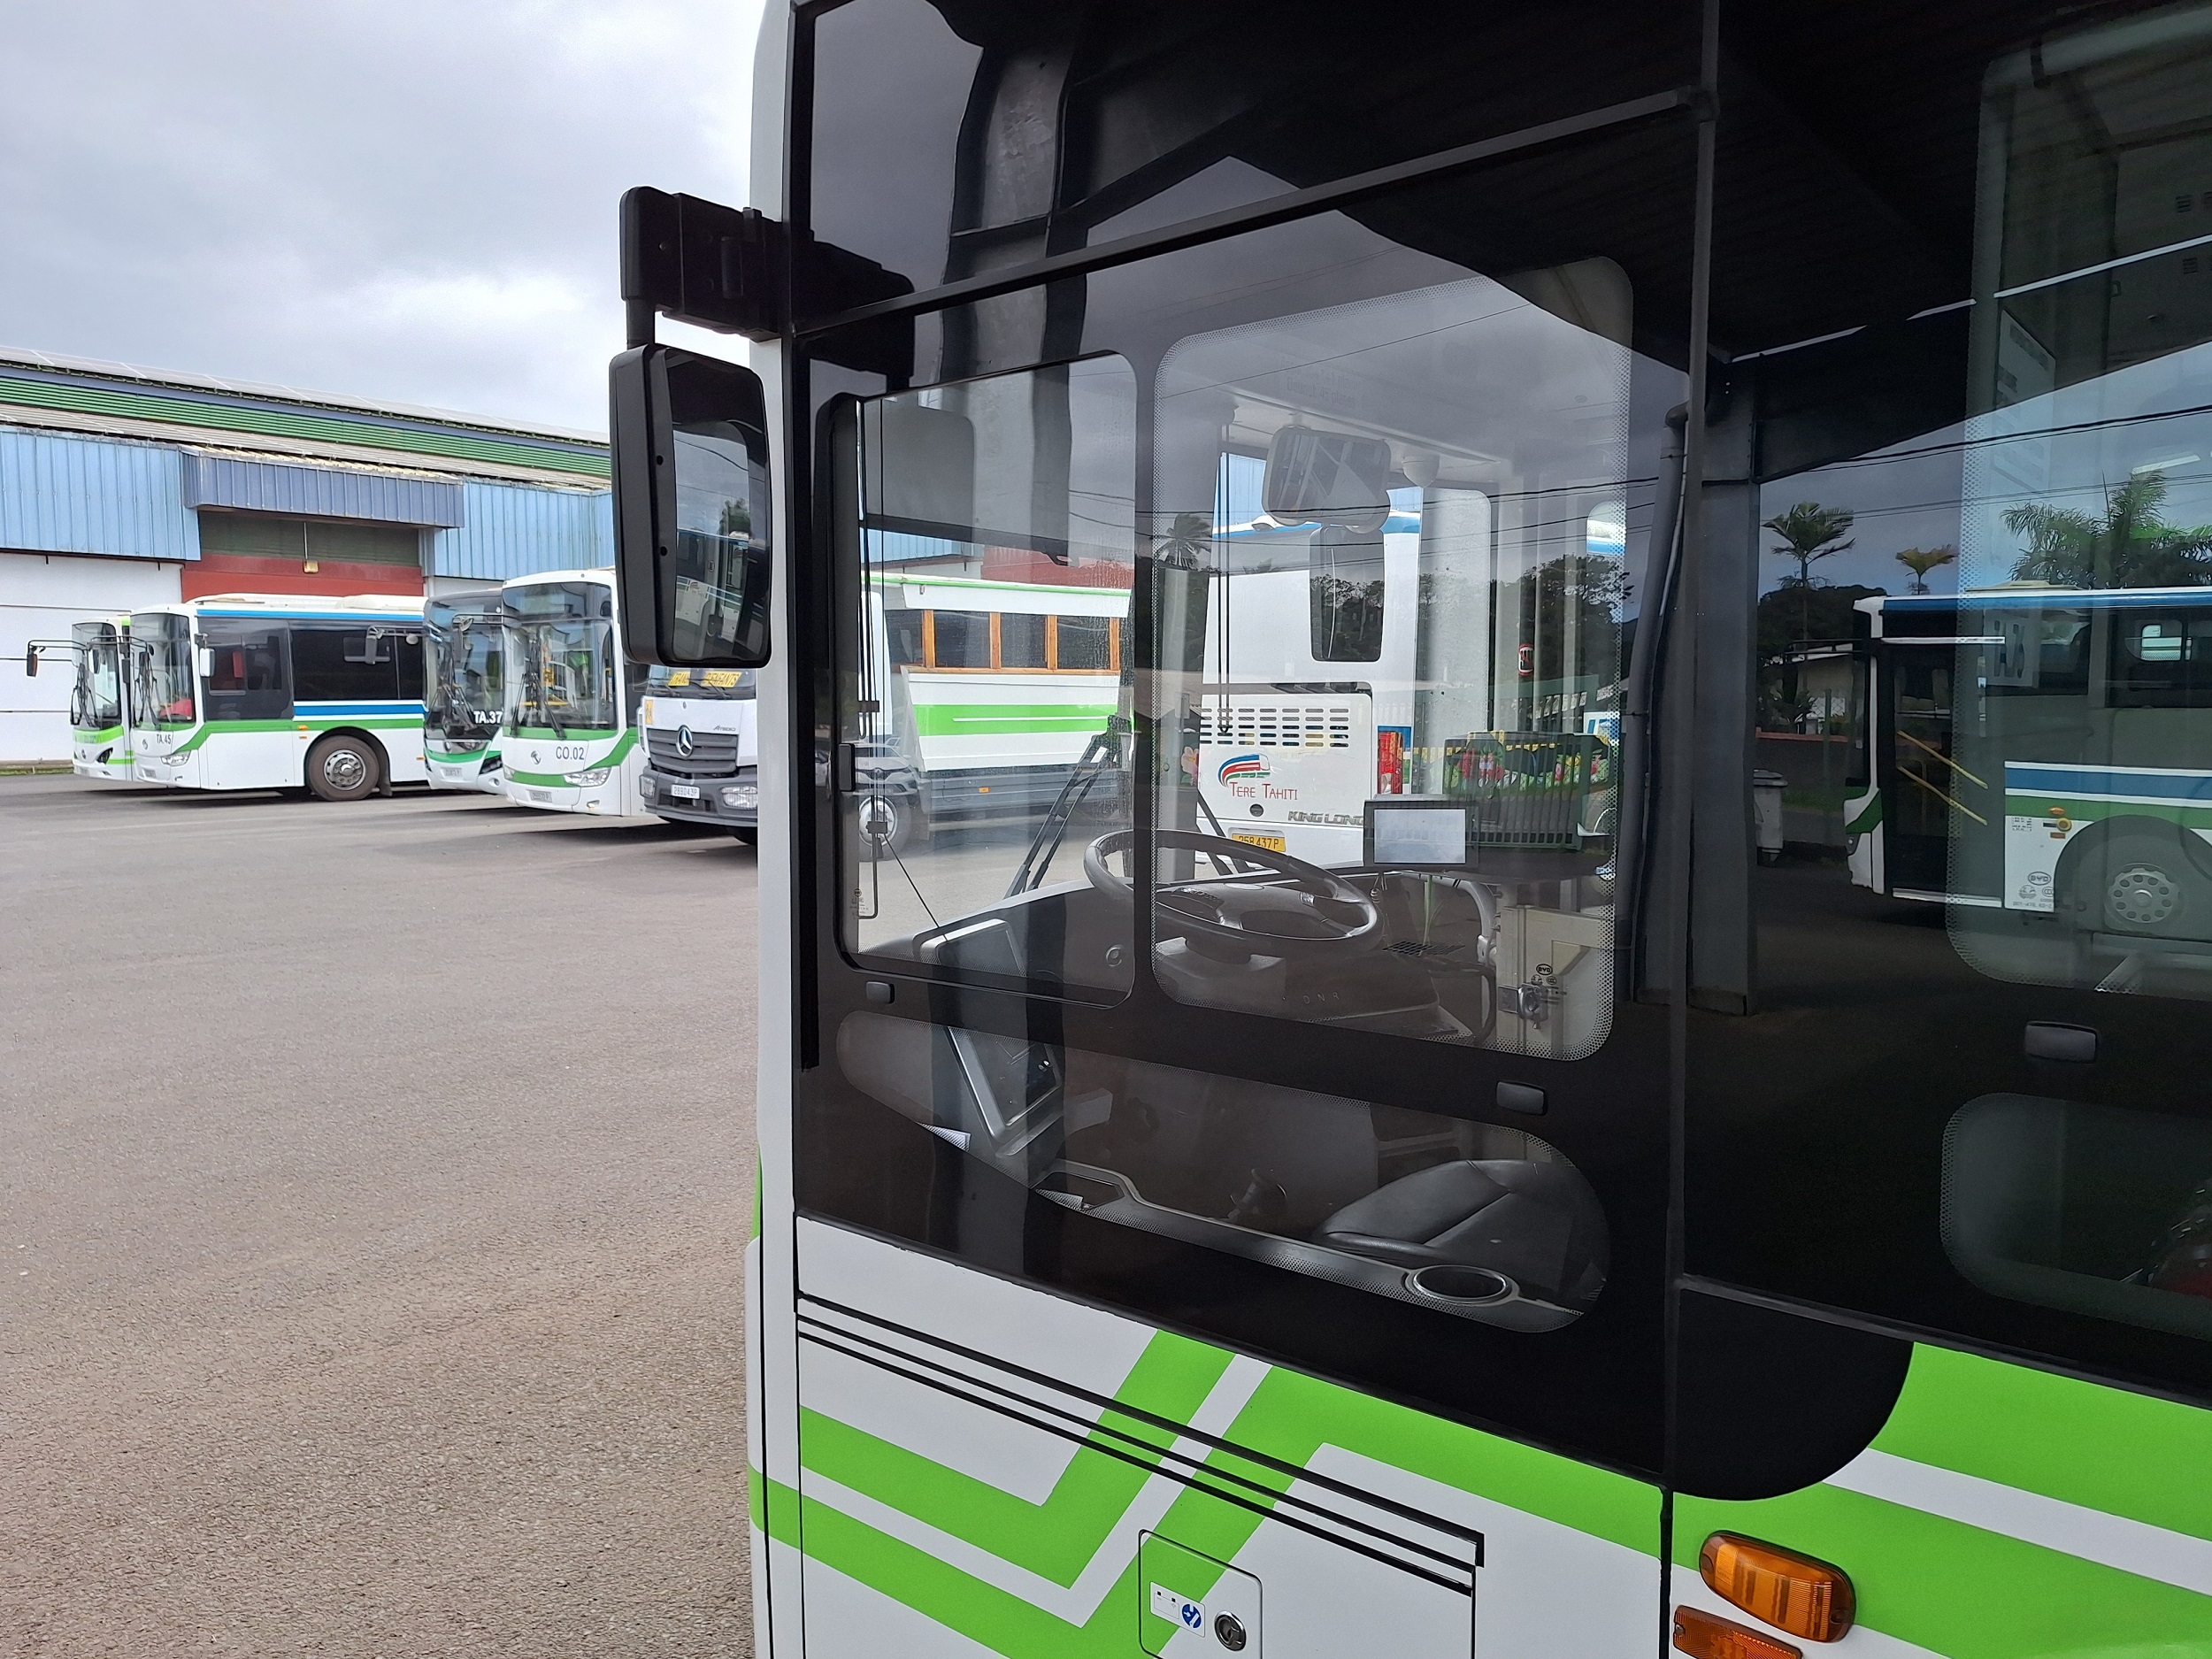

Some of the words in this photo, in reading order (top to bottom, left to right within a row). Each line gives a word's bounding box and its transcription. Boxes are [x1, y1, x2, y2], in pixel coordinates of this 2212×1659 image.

[473, 710, 503, 724] TA.37
[157, 733, 172, 744] TA.45
[555, 746, 585, 760] CO.02
